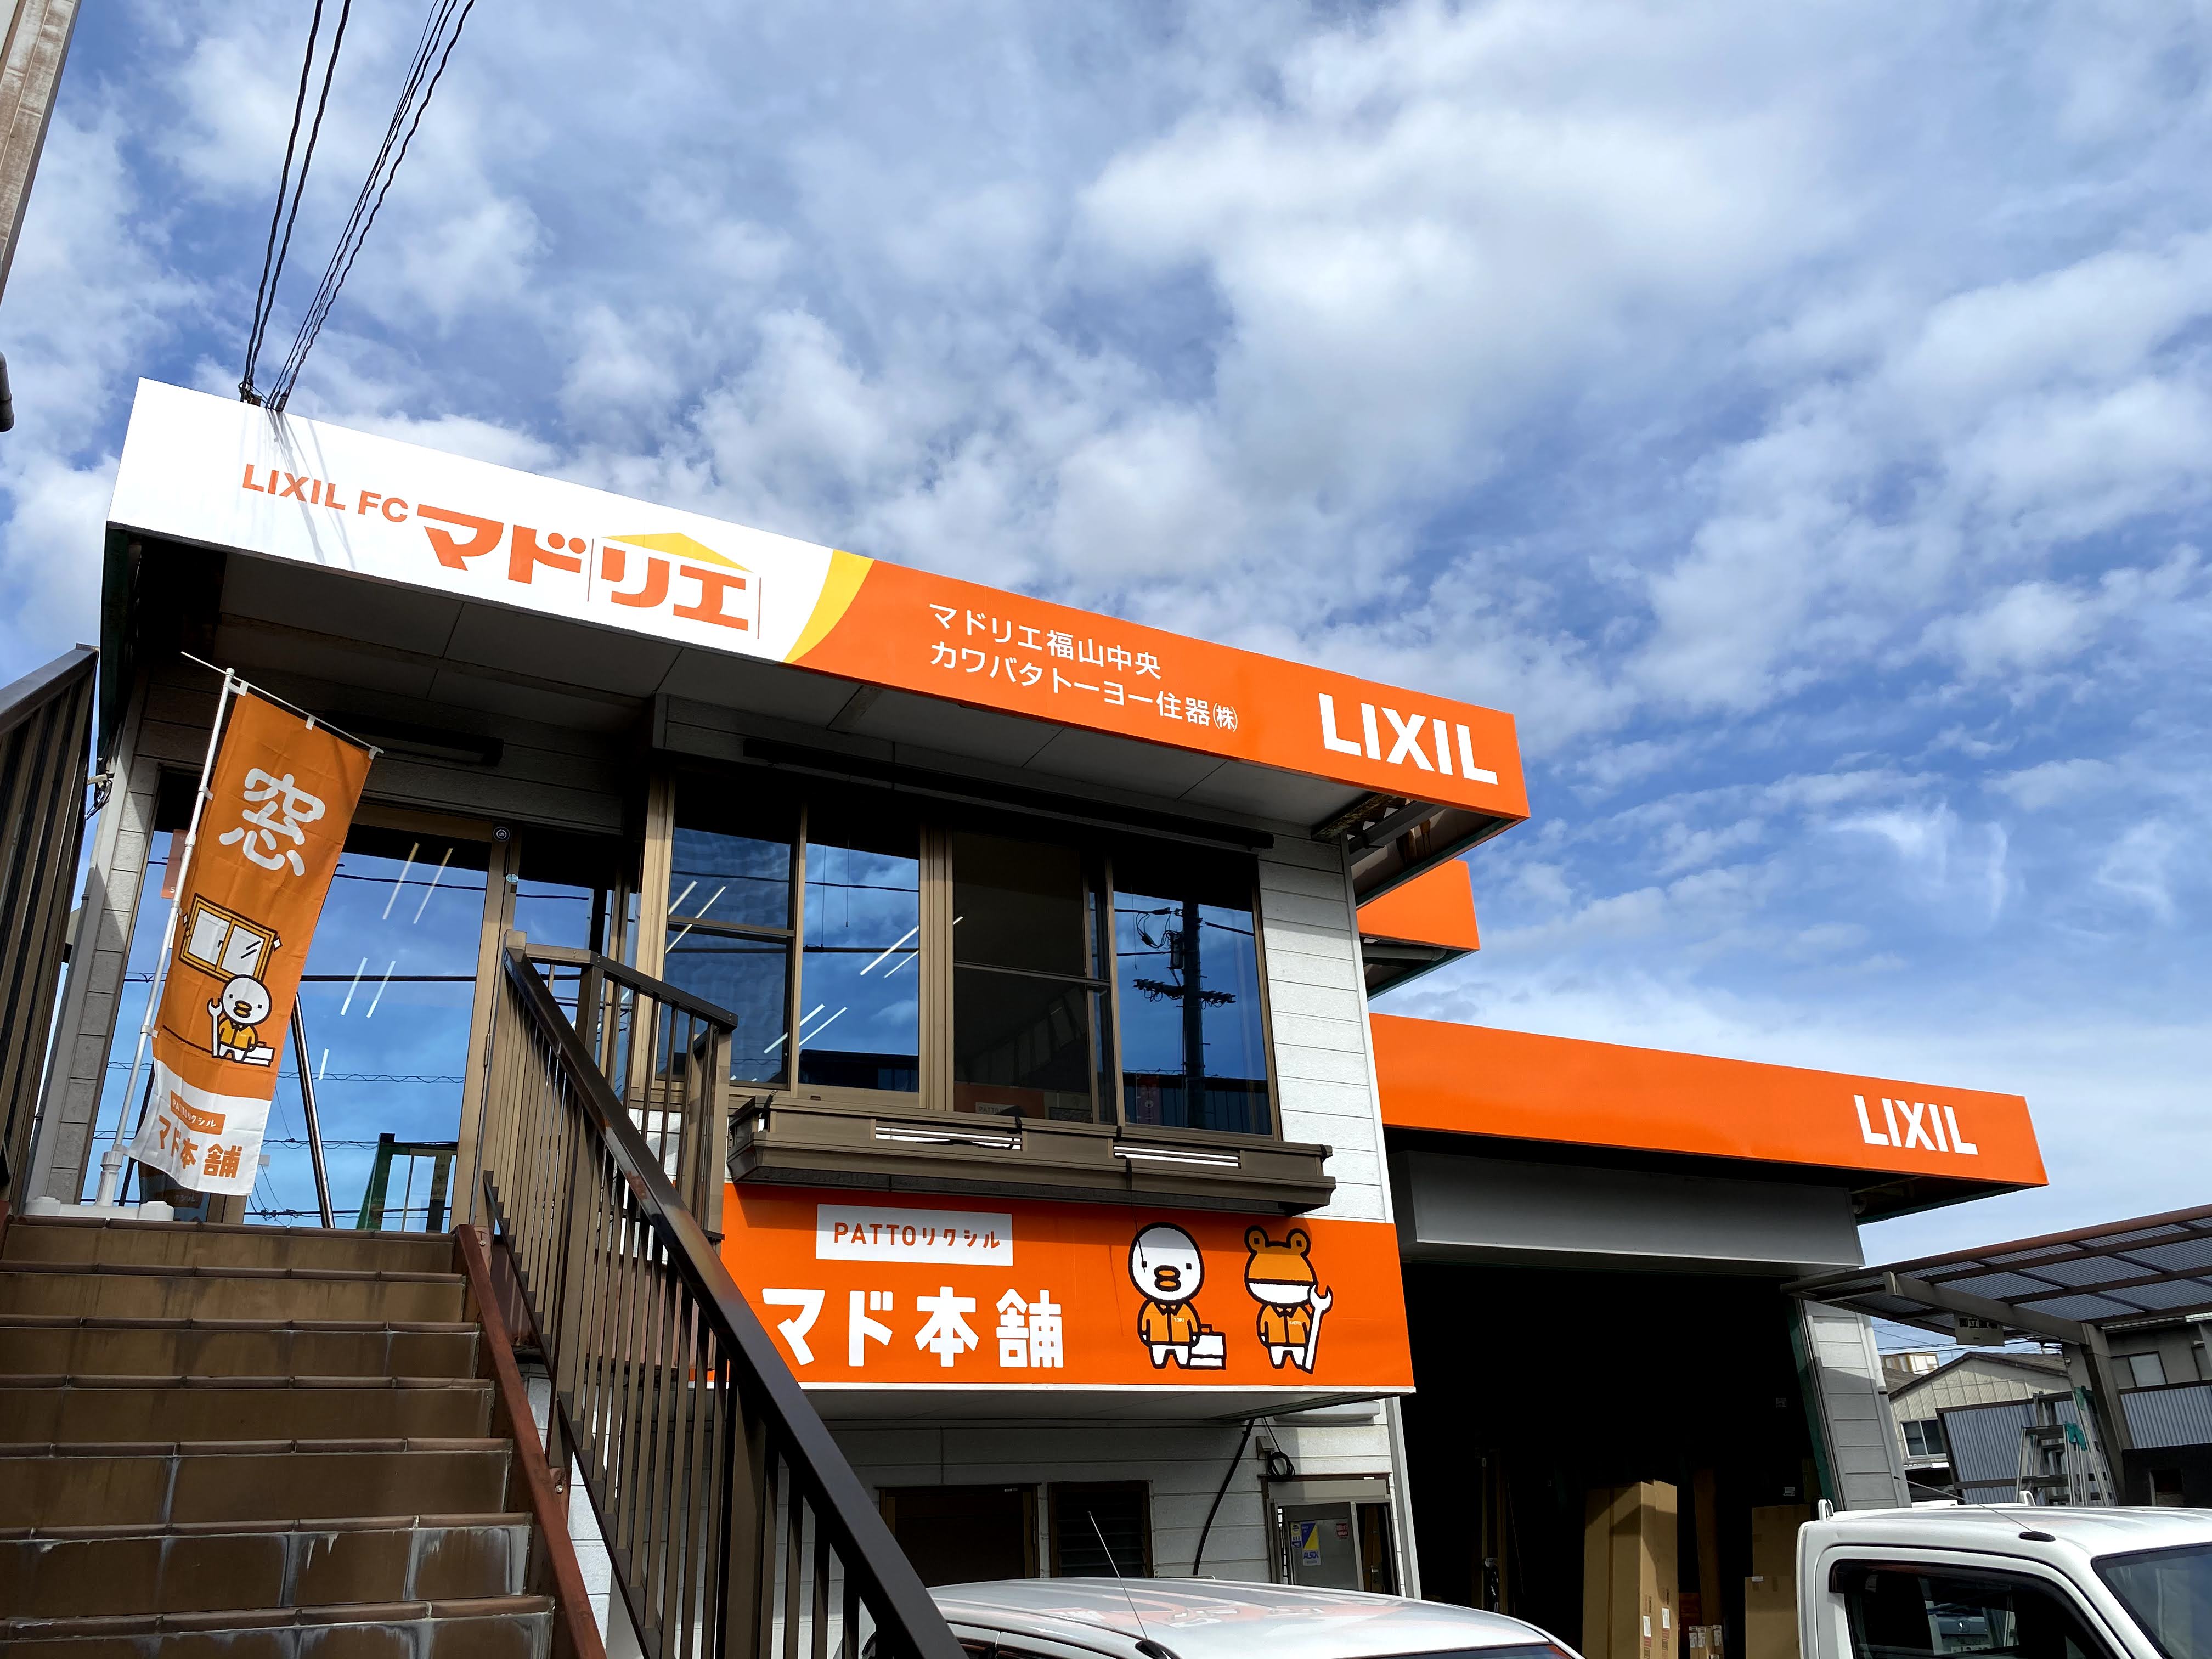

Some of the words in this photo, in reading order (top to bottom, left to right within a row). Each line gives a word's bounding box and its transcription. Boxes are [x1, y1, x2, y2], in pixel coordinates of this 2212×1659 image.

[242, 464, 346, 510] LIXIL
[358, 490, 408, 523] FC
[417, 504, 749, 631] マドリエ
[929, 603, 1161, 680] マドリエ福山中央
[1318, 693, 1498, 785] LIXIL
[219, 768, 326, 876] 窓
[1854, 1094, 1979, 1155] LIXIL
[834, 1222, 1000, 1249] PATTOリクシル
[762, 1286, 1064, 1368] マド本舗
